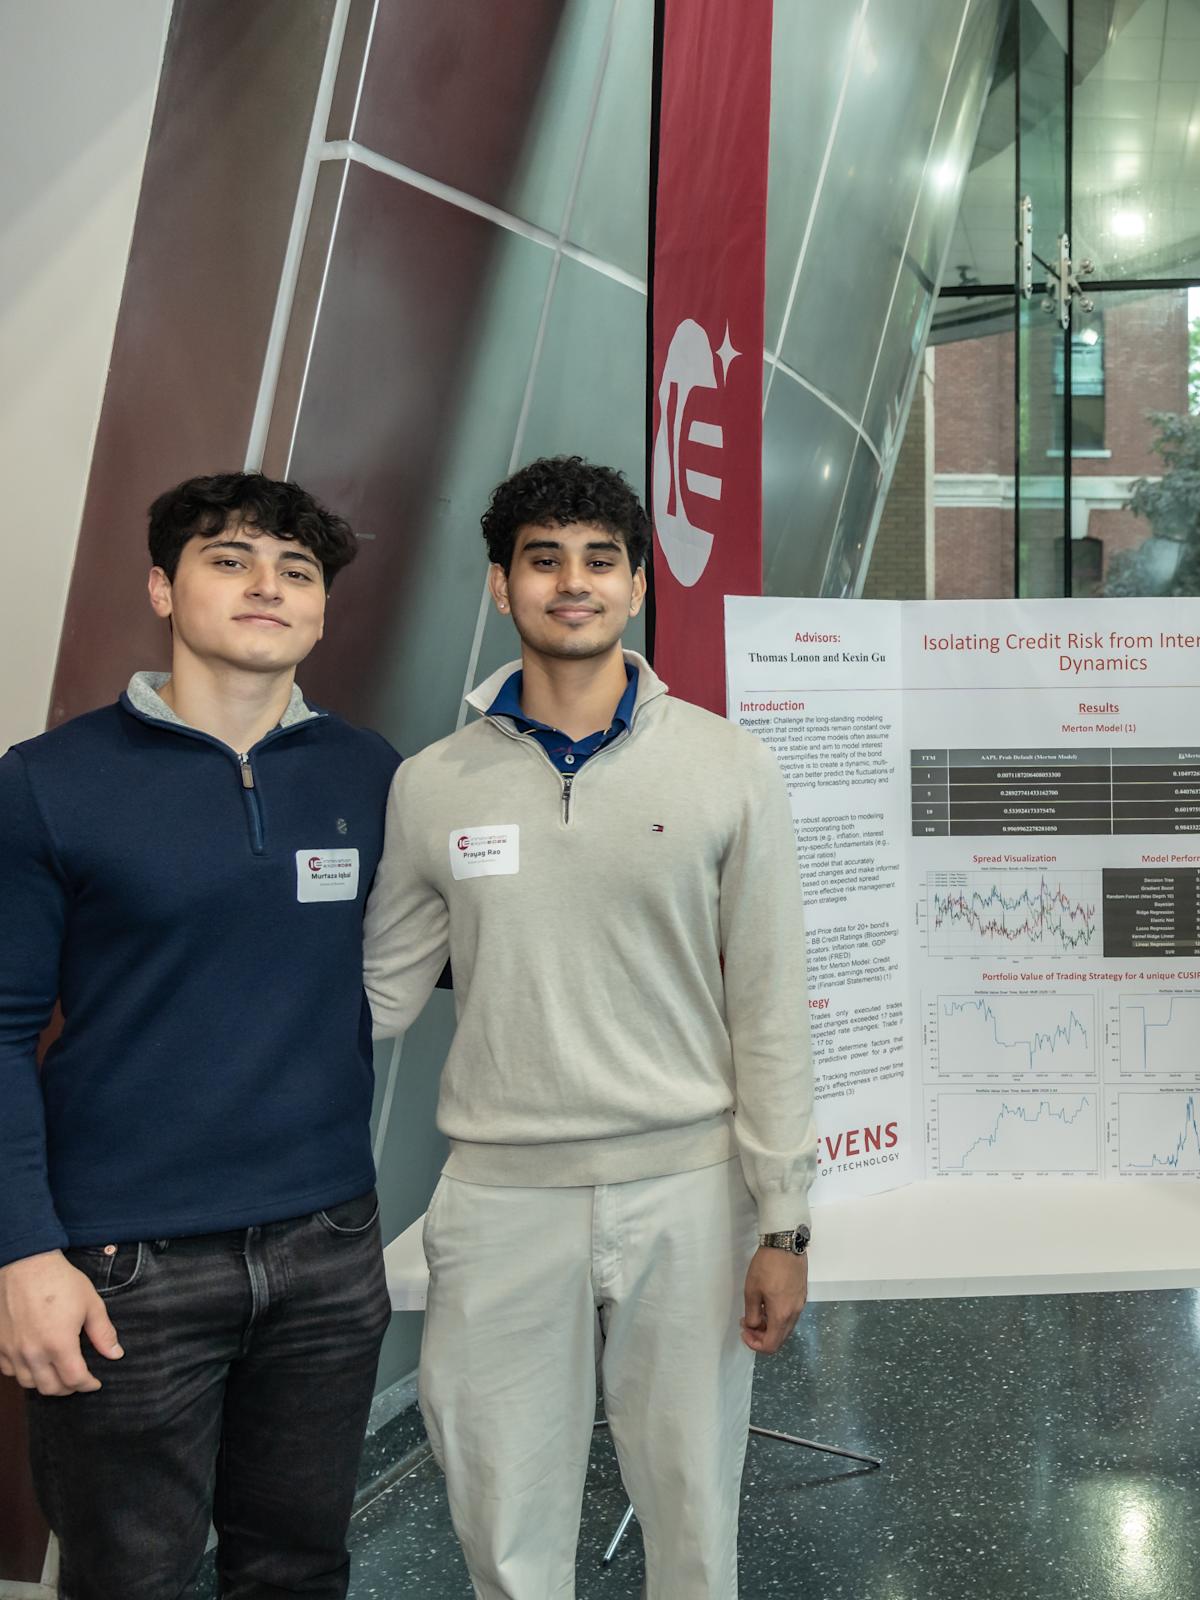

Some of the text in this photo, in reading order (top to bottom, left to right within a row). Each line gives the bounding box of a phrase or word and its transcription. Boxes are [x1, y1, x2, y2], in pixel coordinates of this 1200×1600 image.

[795, 632, 841, 643] Advisors:
[923, 633, 1000, 653] Isolating
[1006, 632, 1061, 650] Credit
[1067, 632, 1104, 649] Risk
[1109, 631, 1153, 649] from
[749, 652, 886, 663] Thomas Lonon and Kexin Gu
[1059, 654, 1148, 674] Dynamics
[740, 700, 805, 712] Introduction
[1079, 702, 1120, 713] Results
[773, 717, 804, 725] Challenge
[815, 715, 855, 724] long-standing
[856, 715, 883, 723] modeling
[806, 726, 830, 734] spreads
[1061, 723, 1137, 733] Merton Model (1)
[861, 741, 883, 749] interest
[777, 752, 819, 761] oversimplifies
[830, 752, 849, 760] reality
[819, 761, 839, 769] create
[805, 768, 888, 778] better predict fluctuations
[817, 777, 877, 787] forecasting accuracy
[800, 816, 820, 824] robust
[821, 815, 850, 823] approach
[801, 824, 841, 834] incorporating
[862, 830, 884, 838] interest
[833, 840, 874, 849] fundamentals
[463, 848, 501, 859] Prayag Rao
[1141, 854, 1169, 863] Model
[811, 858, 875, 869] model accurately
[972, 853, 1057, 865] Spread Visualization
[311, 872, 337, 880] Murtaza
[818, 869, 844, 878] changes
[830, 876, 858, 886] expected
[820, 882, 896, 895] effective management
[819, 895, 847, 905] strategies
[840, 933, 863, 943] Ratings
[829, 961, 851, 970] Merton
[837, 969, 863, 978] earnings
[982, 972, 1018, 981] Portfolio
[1020, 972, 1044, 981] Value
[1045, 971, 1055, 980] of
[1056, 971, 1087, 982] Trading
[1089, 971, 1123, 982] Strategy
[1125, 971, 1138, 980] for
[1138, 971, 1145, 980] 4
[1146, 971, 1176, 982] unique
[808, 997, 830, 1009] tegy
[810, 1005, 881, 1021] Trades executed
[838, 1042, 868, 1052] determine
[818, 1050, 869, 1065] predictive power
[822, 1067, 879, 1082] Tracking monitored
[832, 1077, 871, 1089] effectiveness
[821, 1152, 900, 1177] OF TECHNOLOGY
